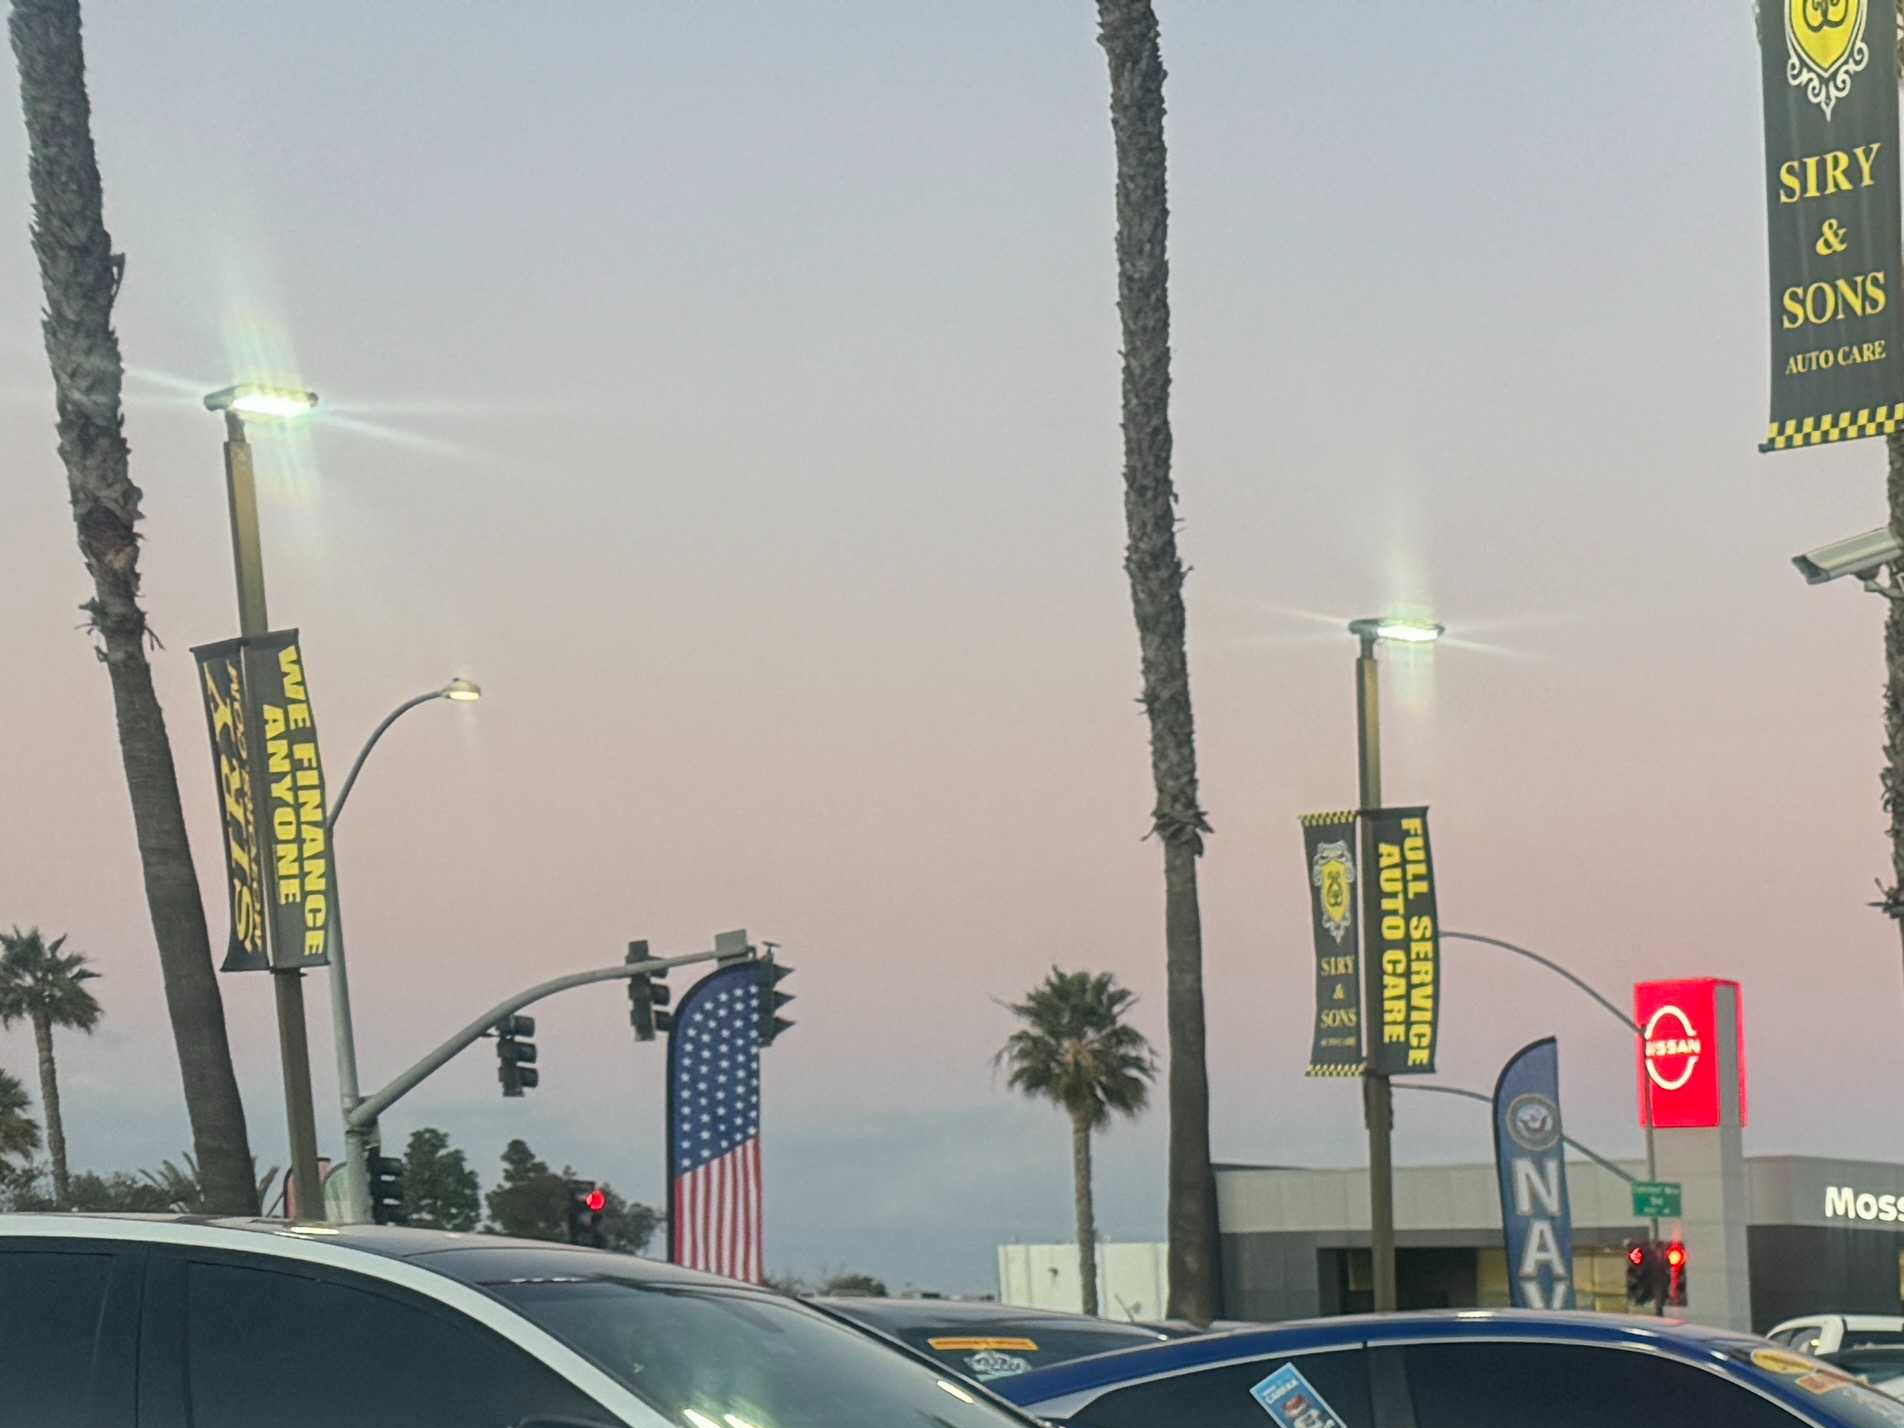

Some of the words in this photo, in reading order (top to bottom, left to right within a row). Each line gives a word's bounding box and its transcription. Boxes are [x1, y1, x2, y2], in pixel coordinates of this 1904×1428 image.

[1779, 143, 1882, 203] SIRY
[1815, 218, 1848, 257] &
[1782, 271, 1886, 330] SONS
[1785, 349, 1834, 375] AUTO
[1838, 340, 1887, 368] CARE
[278, 645, 312, 730] WE
[203, 661, 253, 953] SIRY
[262, 703, 301, 906] ANYONE
[292, 742, 328, 957] FINANCE
[1378, 842, 1405, 941] AUTO
[1401, 817, 1430, 900] FULL
[1320, 955, 1356, 977] SIRY
[1381, 949, 1407, 1045] CARE
[1407, 914, 1434, 1067] SERVICE
[1320, 1008, 1357, 1029] SONS
[1511, 1158, 1569, 1310] NAV
